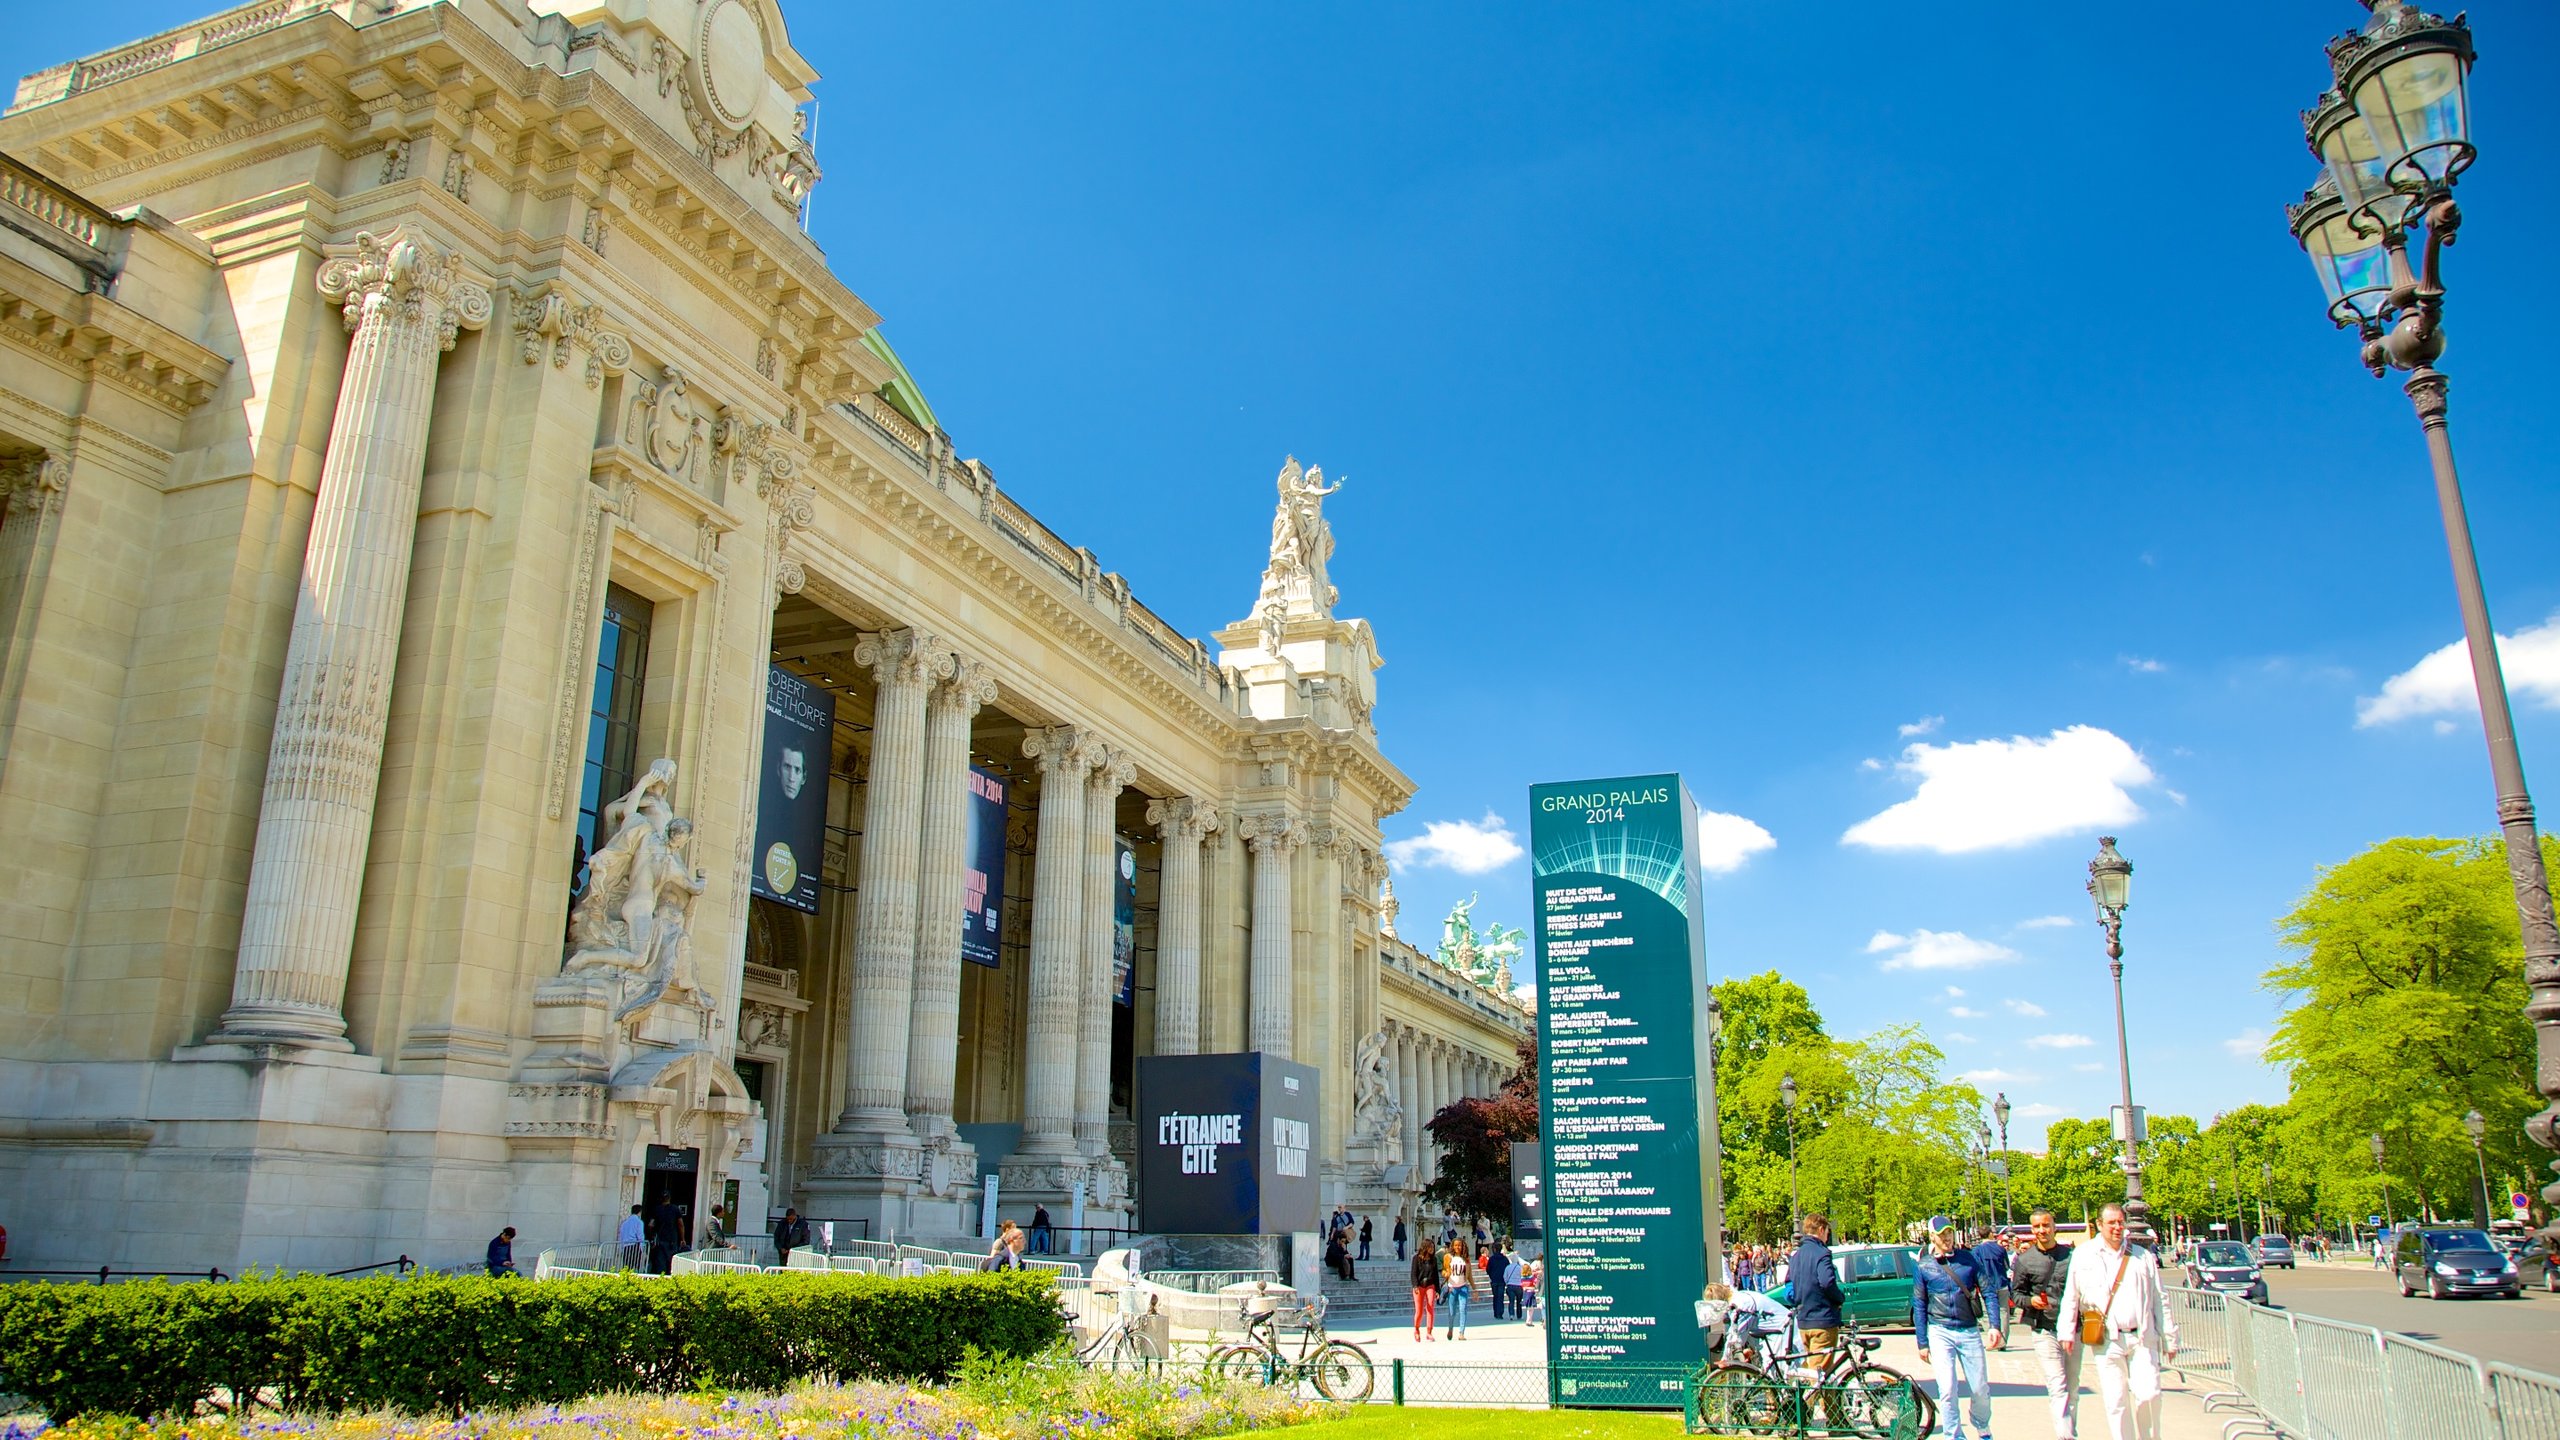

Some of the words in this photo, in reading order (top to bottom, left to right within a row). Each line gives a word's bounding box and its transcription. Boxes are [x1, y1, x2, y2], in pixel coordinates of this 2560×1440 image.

[1543, 794, 1606, 811] GRAND
[1611, 788, 1668, 806] PALAIS
[1587, 808, 1625, 824] 2014
[1546, 889, 1565, 898] NUIT
[1578, 887, 1603, 896] CHINE
[1546, 897, 1558, 905] AU
[1559, 895, 1588, 904] GRAND
[1588, 893, 1616, 902] PALAIS
[1547, 914, 1579, 924] REEBOK
[1584, 913, 1599, 921] LES
[1599, 912, 1623, 920] MILLS
[1547, 921, 1579, 931] FITNESS
[1579, 920, 1605, 929] SHOW
[1548, 941, 1573, 950] VENTE
[1574, 940, 1591, 948] AUX
[1592, 937, 1634, 947] ENCHÈRES
[1548, 947, 1589, 957] BONHAMS
[1549, 968, 1565, 976] BILL
[1565, 967, 1591, 975] VIOLA
[1550, 986, 1570, 995] SAUT
[1571, 984, 1604, 994] HERMÈS
[1550, 994, 1562, 1002] AU
[1562, 993, 1592, 1002] GRAND
[1593, 992, 1620, 1000] PALAIS
[1551, 1019, 1593, 1029] EMPEREUR
[1594, 1019, 1606, 1027] DE
[1551, 1039, 1583, 1048] ROBERT
[1584, 1037, 1648, 1047] MAPPLETHORPE
[1552, 1059, 1568, 1067] ART
[1569, 1058, 1592, 1067] PARIS
[1592, 1058, 1609, 1066] ART
[1609, 1057, 1628, 1065] FAIR
[1553, 1077, 1581, 1087] SOIRÉE
[1576, 1097, 1599, 1105] AUTO
[1600, 1096, 1625, 1105] OPTIC
[1554, 1117, 1581, 1126] SALON
[1582, 1117, 1595, 1125] DU
[1596, 1116, 1619, 1125] LIVRE
[1159, 1111, 1241, 1144] L'ÉTRANGE
[1566, 1124, 1609, 1133] L'ESTAMPE
[1610, 1124, 1620, 1132] ET
[1621, 1123, 1634, 1132] DU
[1635, 1123, 1665, 1131] DESSIN
[1554, 1145, 1593, 1154] CANDIDO
[1594, 1144, 1639, 1152] PORTINARI
[1555, 1152, 1587, 1161] GUERRE
[1588, 1152, 1598, 1160] ET
[1599, 1152, 1618, 1160] PAIX
[1555, 1172, 1610, 1181] MONUMENTA
[1556, 1188, 1573, 1196] ILYA
[1574, 1188, 1584, 1196] ET
[1585, 1188, 1613, 1196] EMILIA
[1614, 1187, 1655, 1196] KABAKOV
[1557, 1208, 1597, 1216] BIENNALE
[1615, 1208, 1671, 1216] ANTIQUAIRES
[1558, 1249, 1595, 1257] HOKUSAI
[1559, 1296, 1583, 1304] PARIS
[1584, 1296, 1614, 1304] PHOTO
[1560, 1316, 1570, 1325] LE
[1571, 1316, 1600, 1325] BAISER
[1560, 1324, 1573, 1332] OU
[1575, 1324, 1597, 1333] L'ART
[1578, 1345, 1590, 1353] EN
[1591, 1346, 1626, 1354] CAPITAL
